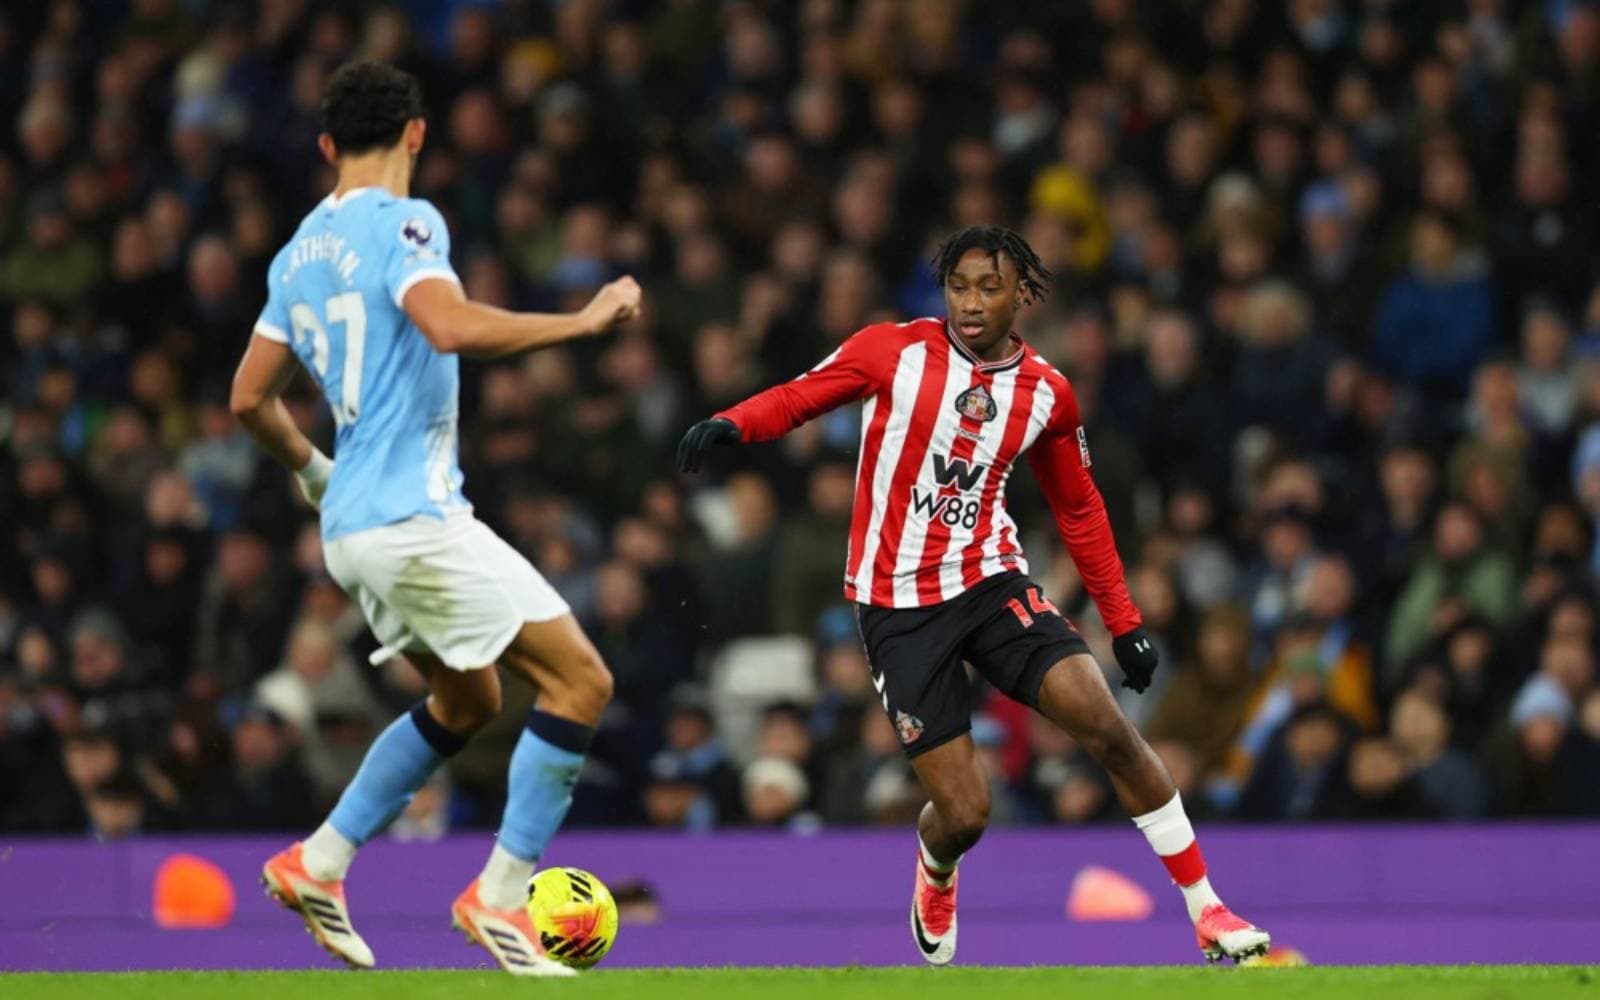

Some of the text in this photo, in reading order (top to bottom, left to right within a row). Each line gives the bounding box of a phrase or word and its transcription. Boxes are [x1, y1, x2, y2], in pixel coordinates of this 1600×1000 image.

[913, 487, 979, 529] W88
[1004, 587, 1061, 629] 14
[1134, 638, 1150, 653] 14
